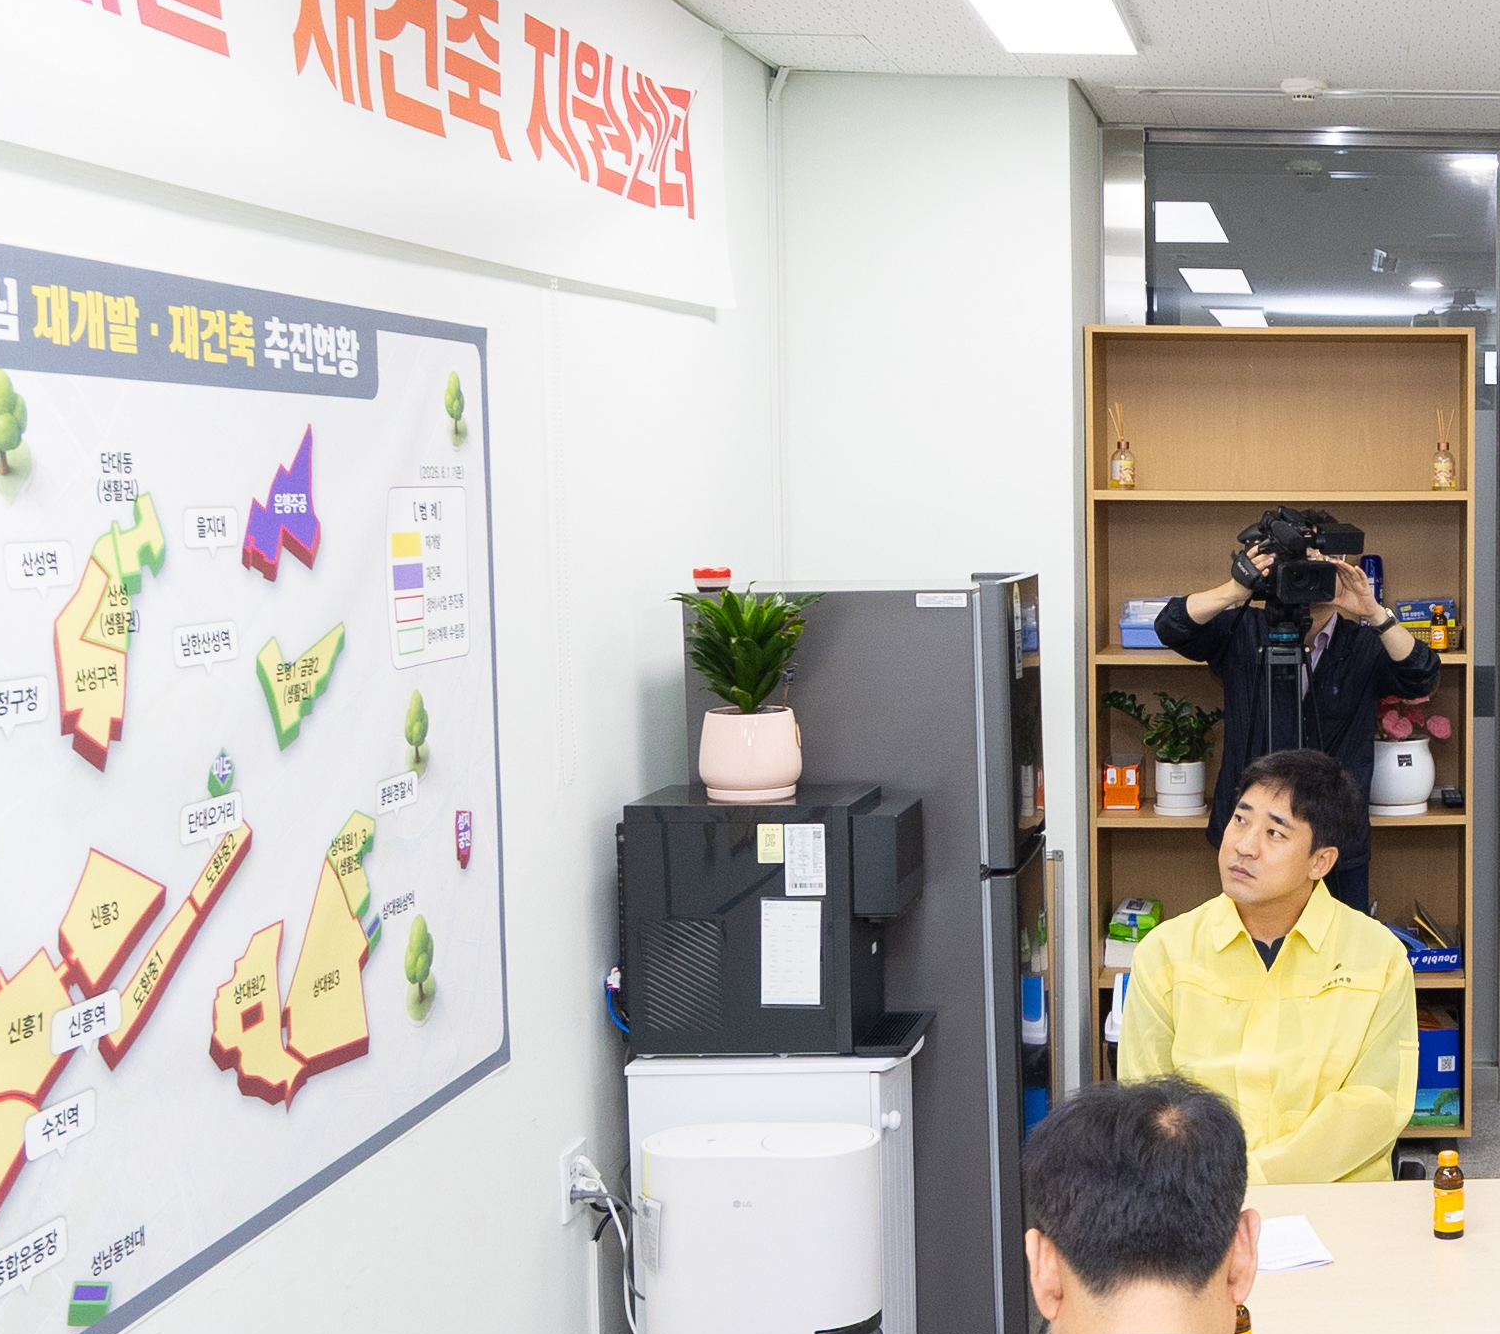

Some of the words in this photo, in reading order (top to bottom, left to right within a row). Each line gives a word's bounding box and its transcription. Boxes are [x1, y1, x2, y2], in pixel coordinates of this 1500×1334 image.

[523, 11, 698, 222] 지원센터
[263, 315, 360, 378] 추진현황
[100, 452, 133, 474] 단대동
[97, 479, 139, 504] (생활권)
[196, 516, 227, 539] 을지대
[21, 551, 59, 577] 산성역
[107, 584, 129, 607] 산성
[100, 609, 140, 638] (생활권)
[180, 629, 232, 657] 남한산성역
[75, 664, 119, 692] 산성구역
[188, 799, 236, 835] 단대오거리
[89, 900, 120, 930] 신흥3
[1411, 957, 1419, 966] A
[1422, 955, 1458, 964] Double
[233, 974, 266, 1005] 상대원2
[312, 969, 341, 998] 상대원3
[7, 1012, 44, 1045] 신흥1
[68, 1002, 106, 1039] 신흥역
[41, 1103, 79, 1143] 수진역
[90, 1224, 146, 1277] 성남동현대
